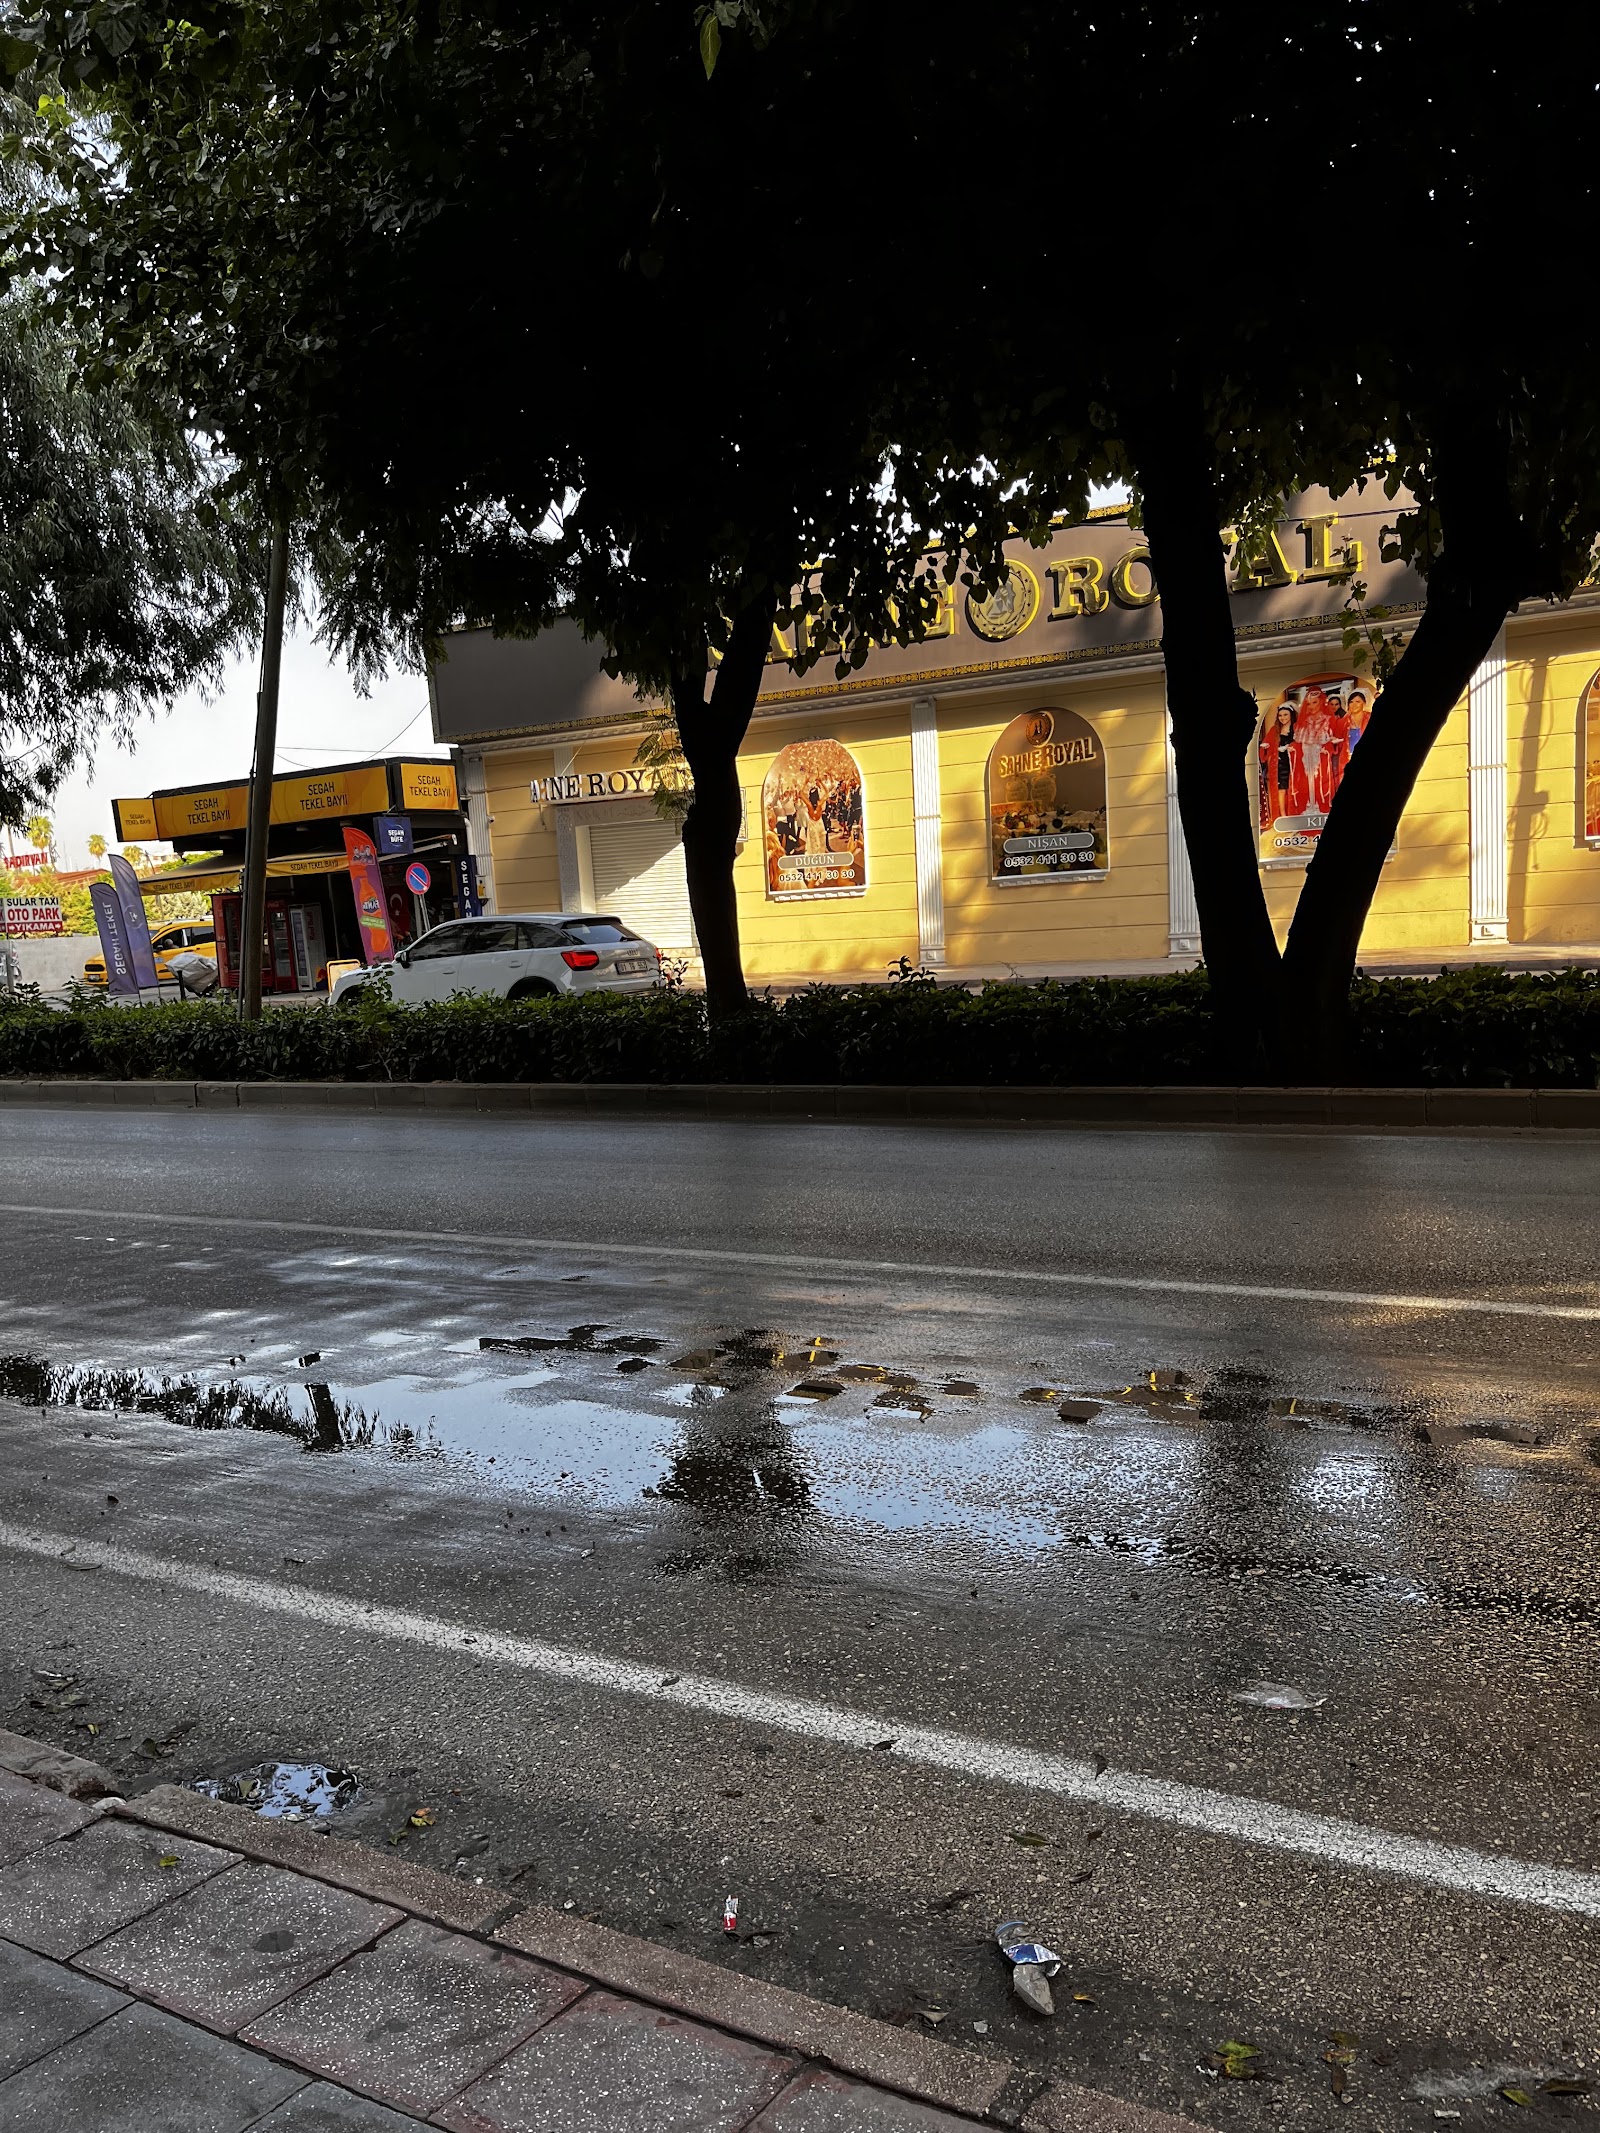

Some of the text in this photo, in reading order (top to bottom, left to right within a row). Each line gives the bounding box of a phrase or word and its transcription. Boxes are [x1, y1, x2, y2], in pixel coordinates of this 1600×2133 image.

[1046, 511, 1364, 620] ROAL
[1000, 737, 1096, 778] SAHNE ROYAL
[417, 775, 441, 785] SEGAH
[308, 781, 335, 796] SEGAH
[409, 786, 432, 797] TEKEL
[193, 798, 219, 811] SEGAH
[300, 797, 325, 811] TEKEL
[187, 812, 211, 825] TEKEL
[1028, 836, 1068, 850] NİŞAN
[1275, 836, 1308, 847] 0532
[290, 862, 307, 871] SEGAH
[307, 860, 324, 870] TEKEL
[1004, 851, 1095, 867] 0532 411 30 30
[779, 869, 855, 882] 0532 411 30 30
[39, 897, 59, 906] TAXI
[8, 908, 60, 920] OTO PARK
[15, 923, 55, 931] YIKAMA
